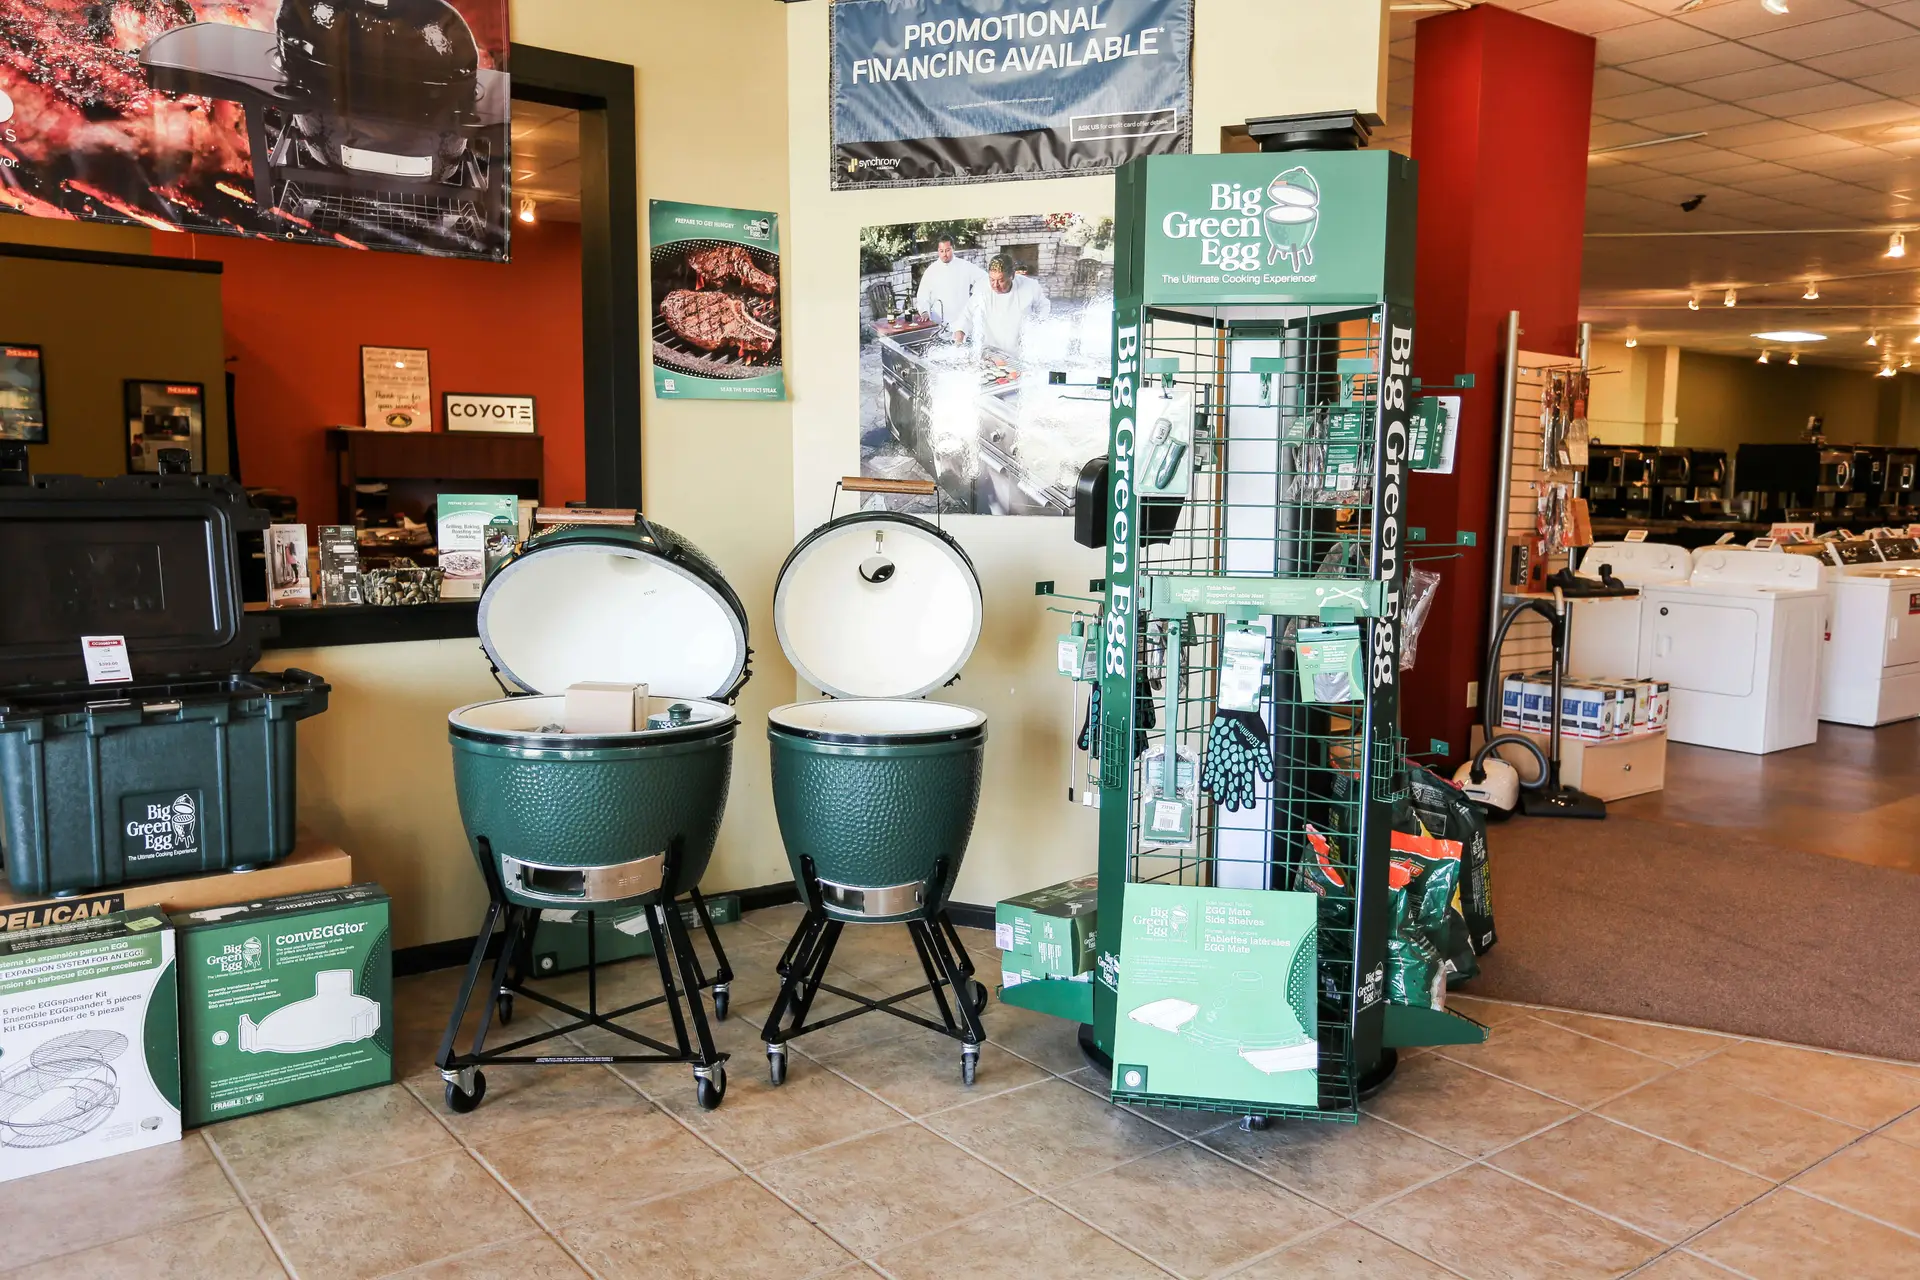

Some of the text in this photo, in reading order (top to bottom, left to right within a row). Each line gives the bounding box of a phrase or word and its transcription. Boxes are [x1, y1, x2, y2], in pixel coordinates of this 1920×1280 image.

[904, 5, 1107, 50] PROMOTIONAL
[852, 48, 996, 85] FINANCING
[858, 156, 900, 169] synchrony
[1210, 183, 1262, 216] Big
[1162, 212, 1262, 238] Green
[1162, 274, 1179, 284] The
[1181, 273, 1220, 284] Ultimate
[1221, 273, 1261, 285] Cooking
[1114, 325, 1137, 409] Big
[1384, 324, 1412, 410] Big
[450, 403, 531, 419] COYOTE
[1112, 417, 1134, 574] Green
[1381, 420, 1406, 580] Green
[147, 804, 172, 821] Big
[126, 822, 172, 836] Green
[137, 852, 155, 860] Ultimate
[1151, 907, 1169, 918] Big
[1206, 906, 1252, 916] EGG Mate
[1133, 915, 1169, 926] Green
[1205, 915, 1266, 926] Side Shelves
[275, 922, 366, 946] convEGGtor
[1146, 925, 1168, 937] Egg
[1205, 934, 1291, 947] Tablettes latérales
[38, 950, 78, 964] expansión
[80, 947, 98, 956] para
[111, 942, 128, 951] EGG
[224, 944, 242, 955] Big
[1228, 944, 1250, 953] Mate
[5, 965, 54, 979] EXPANSION
[56, 959, 90, 970] SYSTEM
[92, 956, 109, 965] FOR
[124, 950, 144, 959] EGG!
[206, 952, 242, 966] Green
[220, 961, 242, 972] Egg
[26, 978, 37, 987] du
[38, 971, 76, 984] barbecue
[77, 968, 95, 978] EGG
[97, 966, 110, 976] par
[111, 958, 152, 970] excellence!
[1366, 972, 1374, 984] Big
[1358, 982, 1374, 997] Green
[3, 1012, 47, 1024] Ensemble
[49, 1002, 104, 1016] EGGspander
[114, 992, 141, 1005] pièces
[11, 1004, 36, 1014] Piece
[38, 994, 94, 1009] EGGspander
[95, 990, 107, 999] Kit
[3, 1025, 16, 1033] Kit
[18, 1016, 75, 1031] EGGspander
[97, 1004, 125, 1017] piezas
[213, 1098, 242, 1110] FRAGILE
